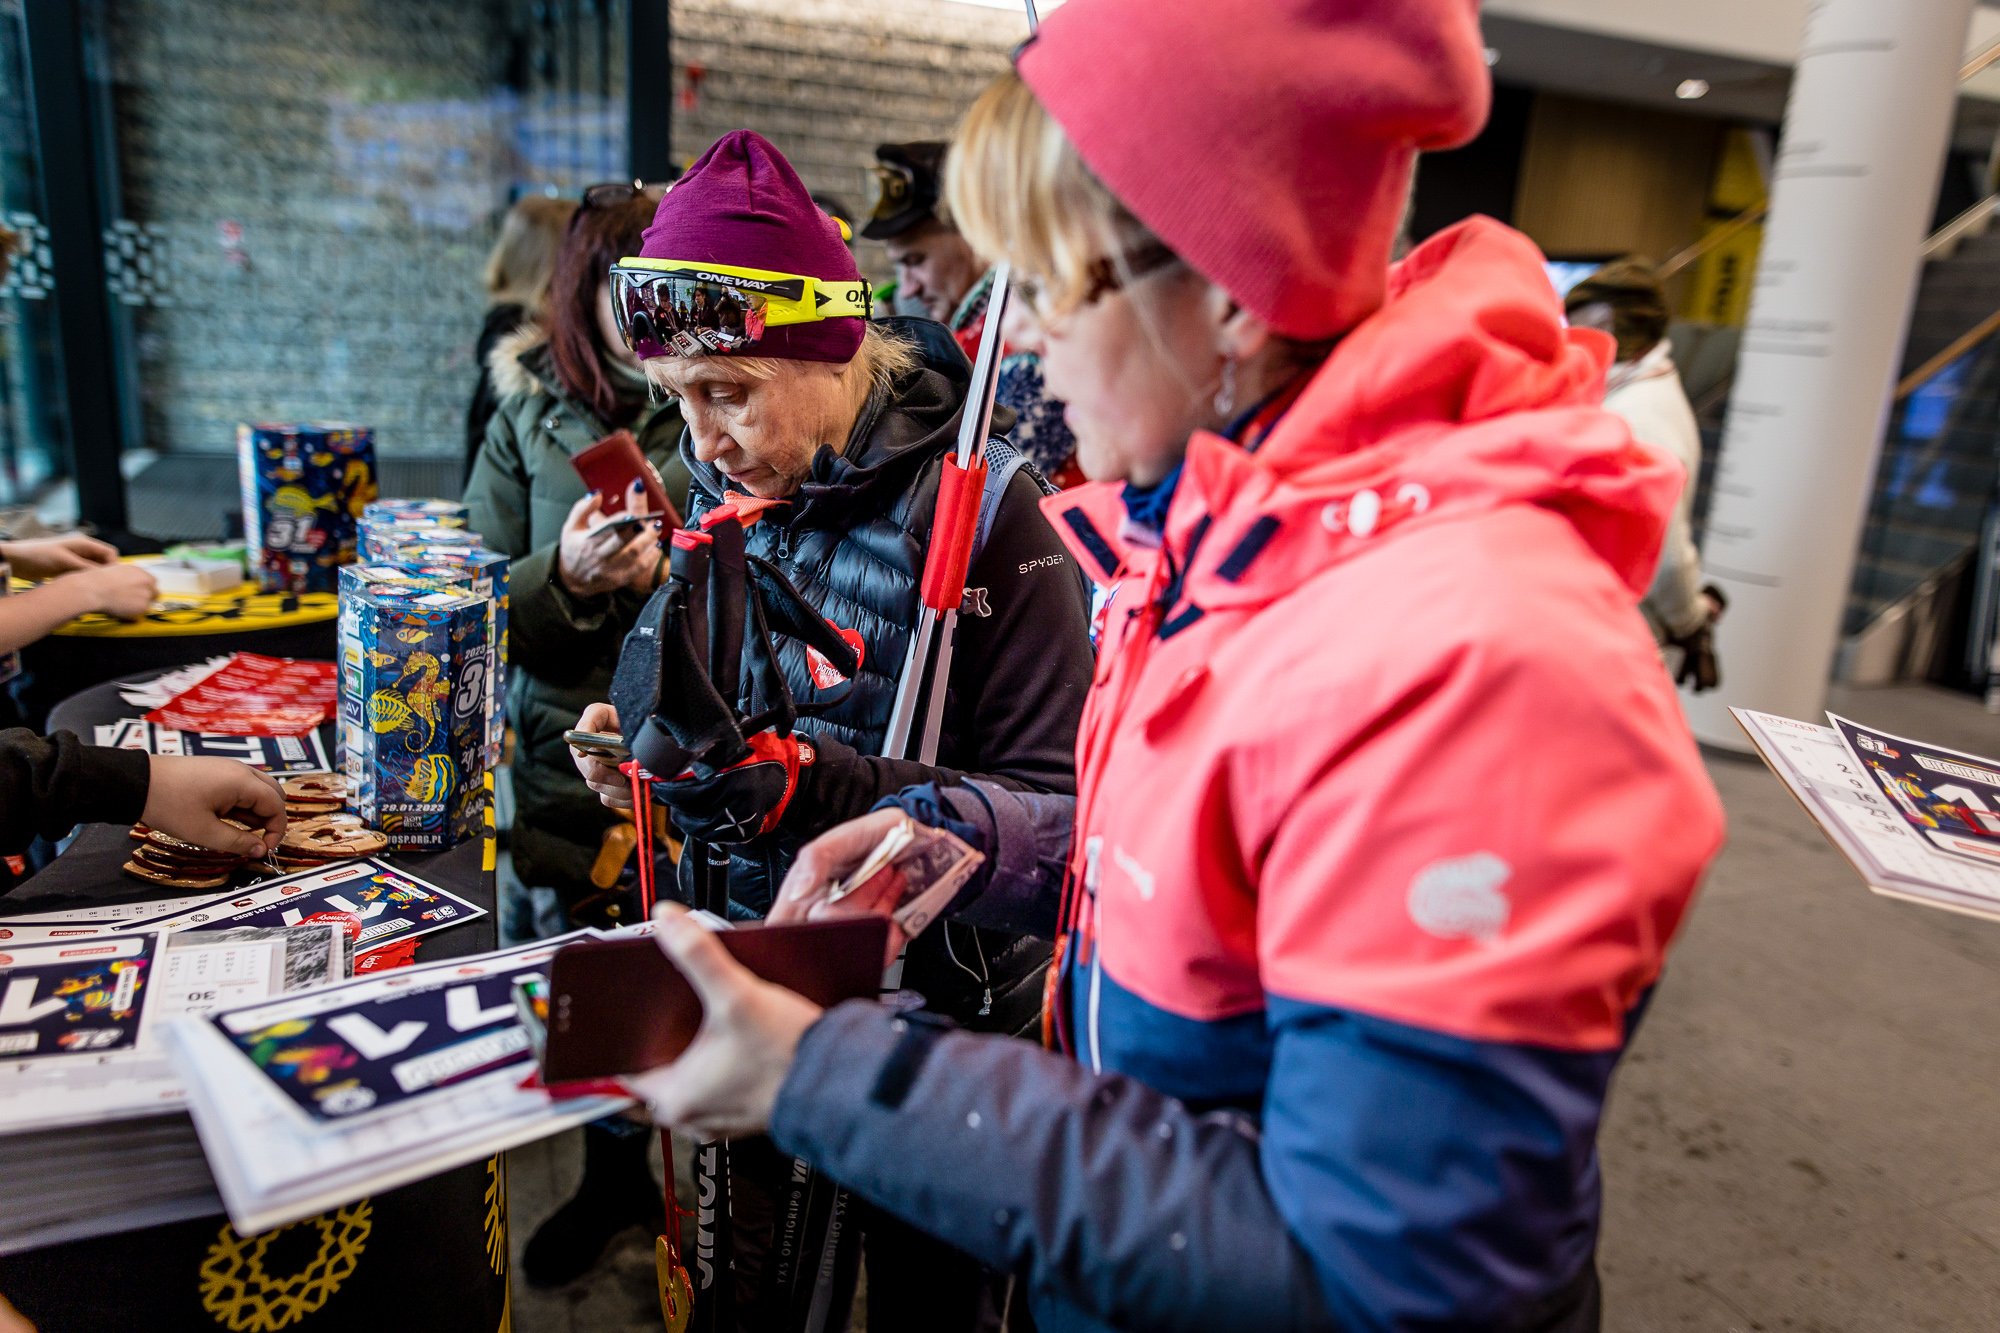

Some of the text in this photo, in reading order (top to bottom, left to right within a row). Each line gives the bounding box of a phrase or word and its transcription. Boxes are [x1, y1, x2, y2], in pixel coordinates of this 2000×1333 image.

[696, 272, 772, 291] ONEWAY
[1018, 555, 1064, 574] SPYDER
[465, 648, 486, 660] 2023
[455, 658, 487, 718] 3
[1837, 763, 1852, 775] 2
[1849, 778, 1863, 789] 9
[1853, 791, 1877, 804] 16
[381, 803, 446, 812] 29.01.2023
[1864, 807, 1891, 820] 23
[697, 1137, 718, 1290] TOMIC
